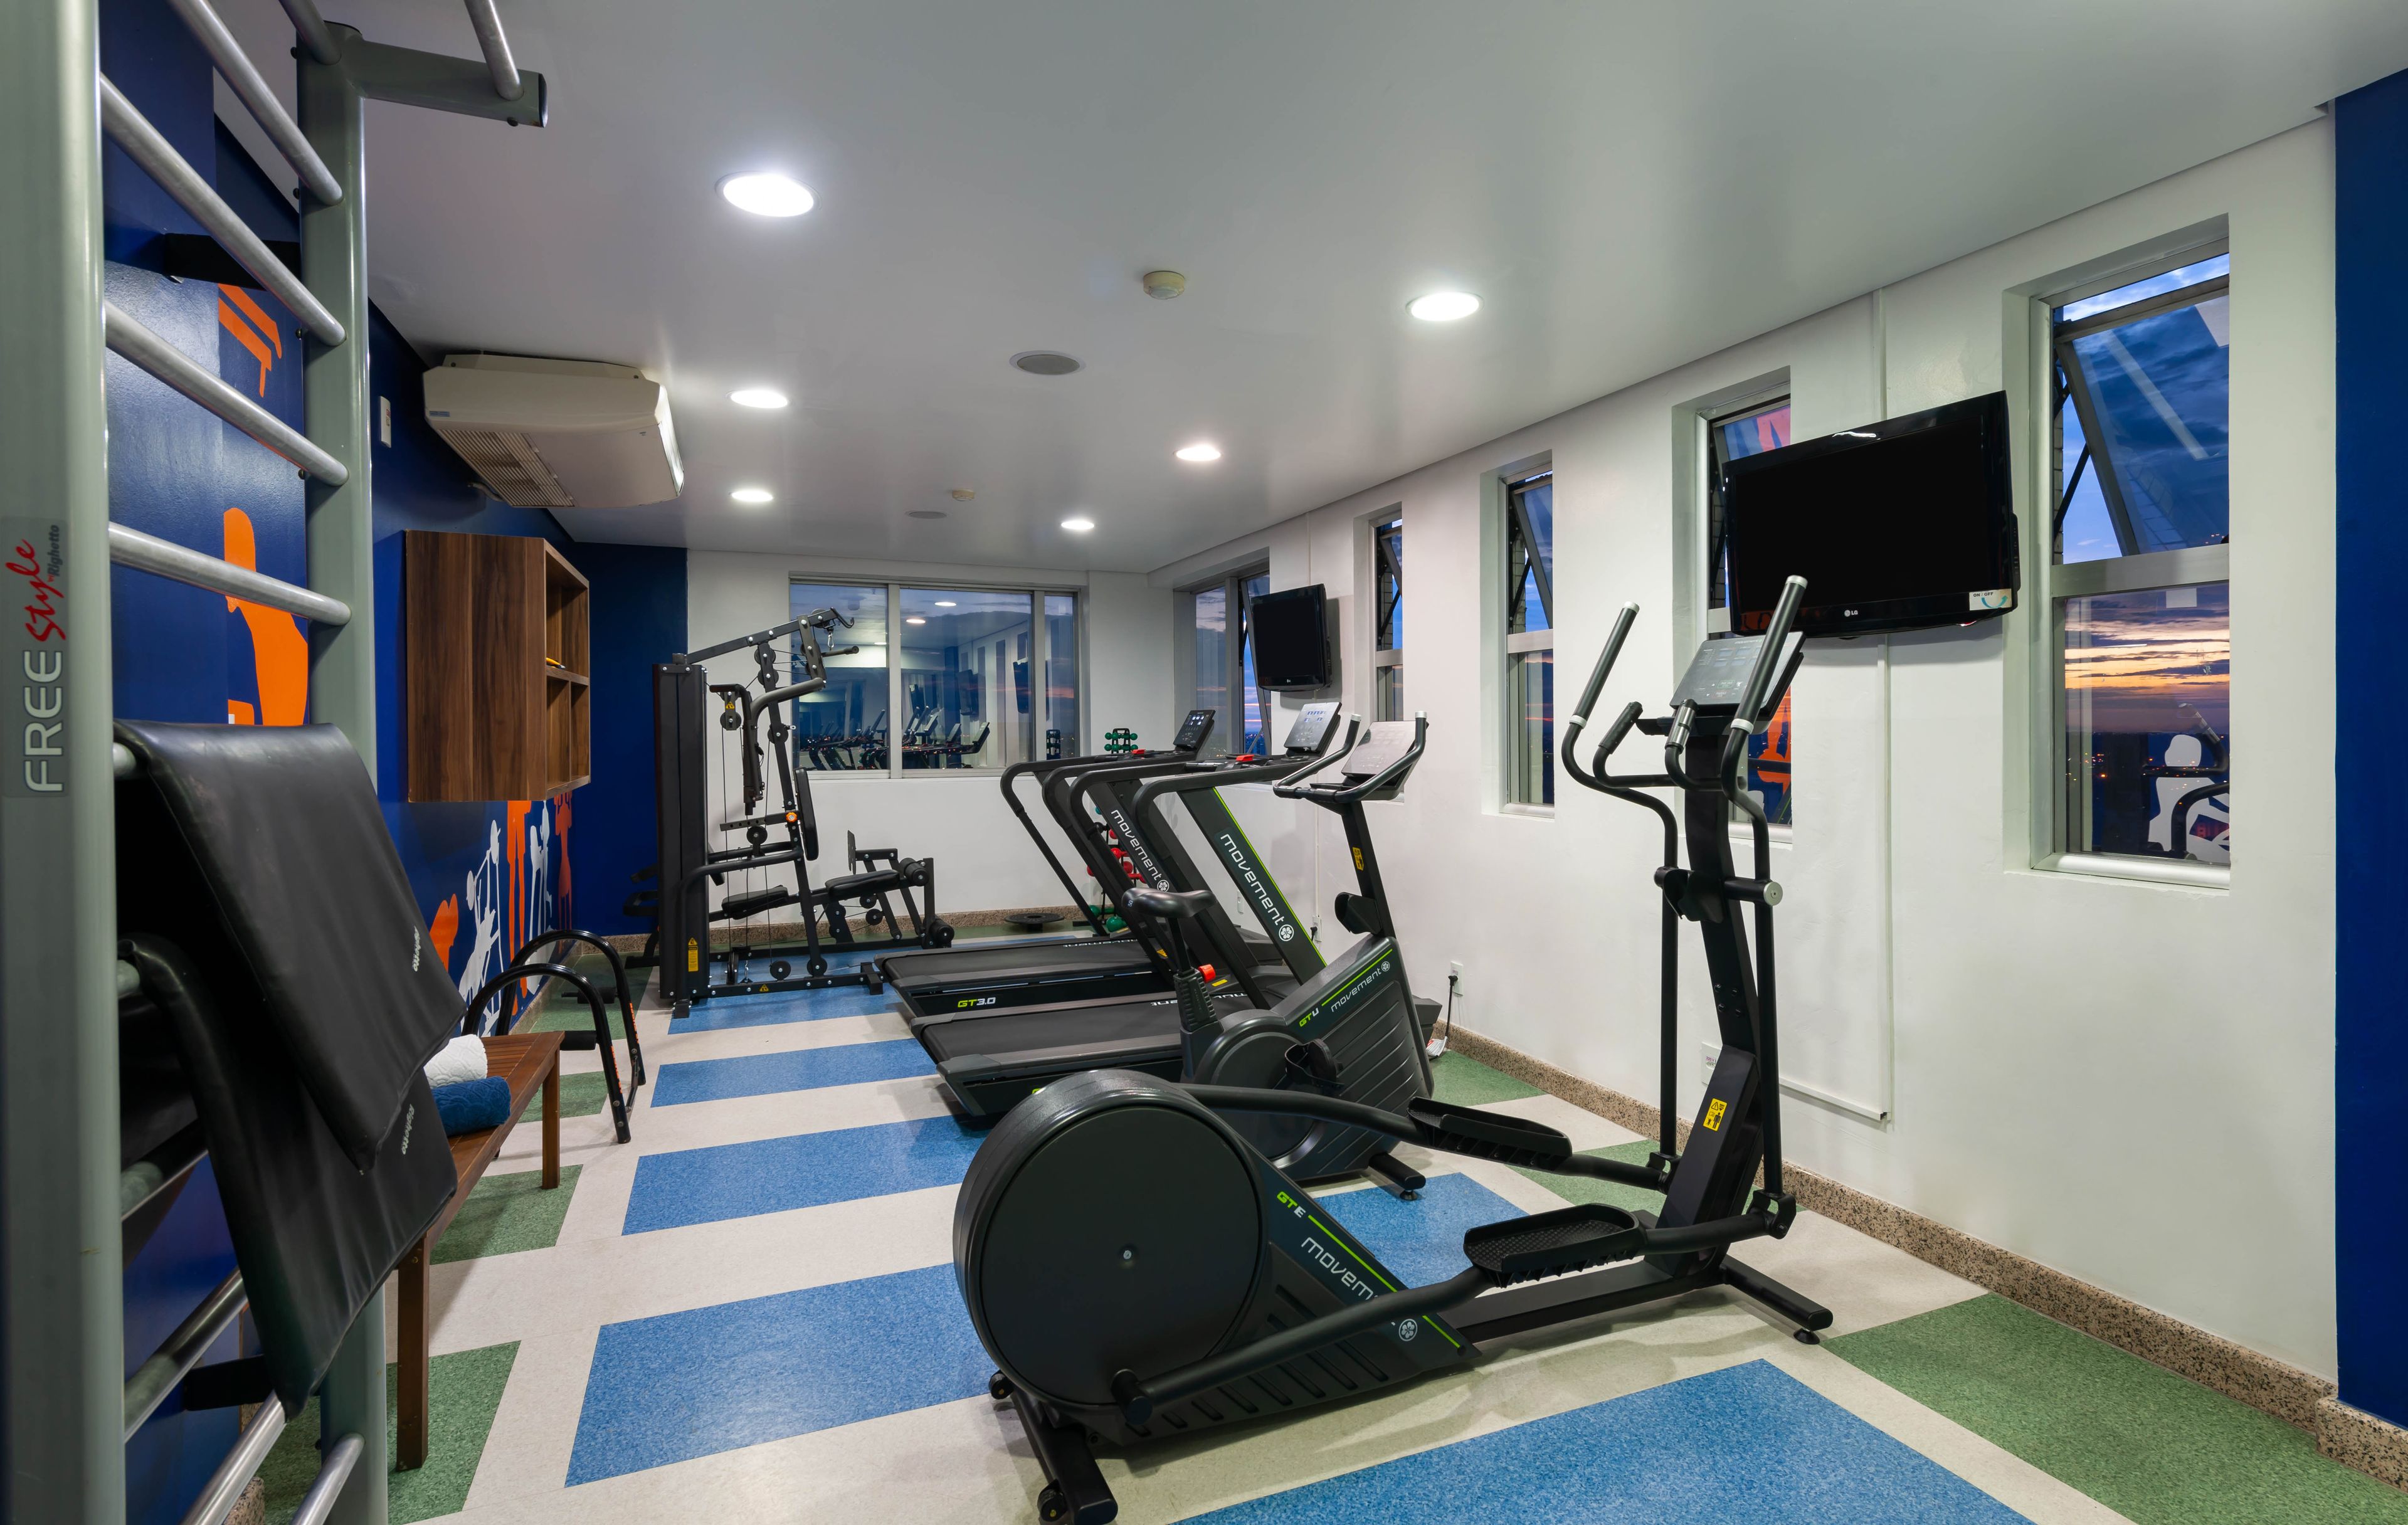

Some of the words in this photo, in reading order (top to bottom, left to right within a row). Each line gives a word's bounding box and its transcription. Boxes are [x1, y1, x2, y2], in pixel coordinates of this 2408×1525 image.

[48, 525, 63, 577] Righetto
[5, 539, 66, 641] Style
[23, 650, 63, 791] FREE
[1111, 810, 1162, 880] movement
[1220, 834, 1285, 926] movement
[958, 997, 996, 1008] GT3.0
[1299, 1008, 1319, 1027] GTU
[1331, 968, 1381, 1013] movement
[1277, 1191, 1306, 1218] GTE
